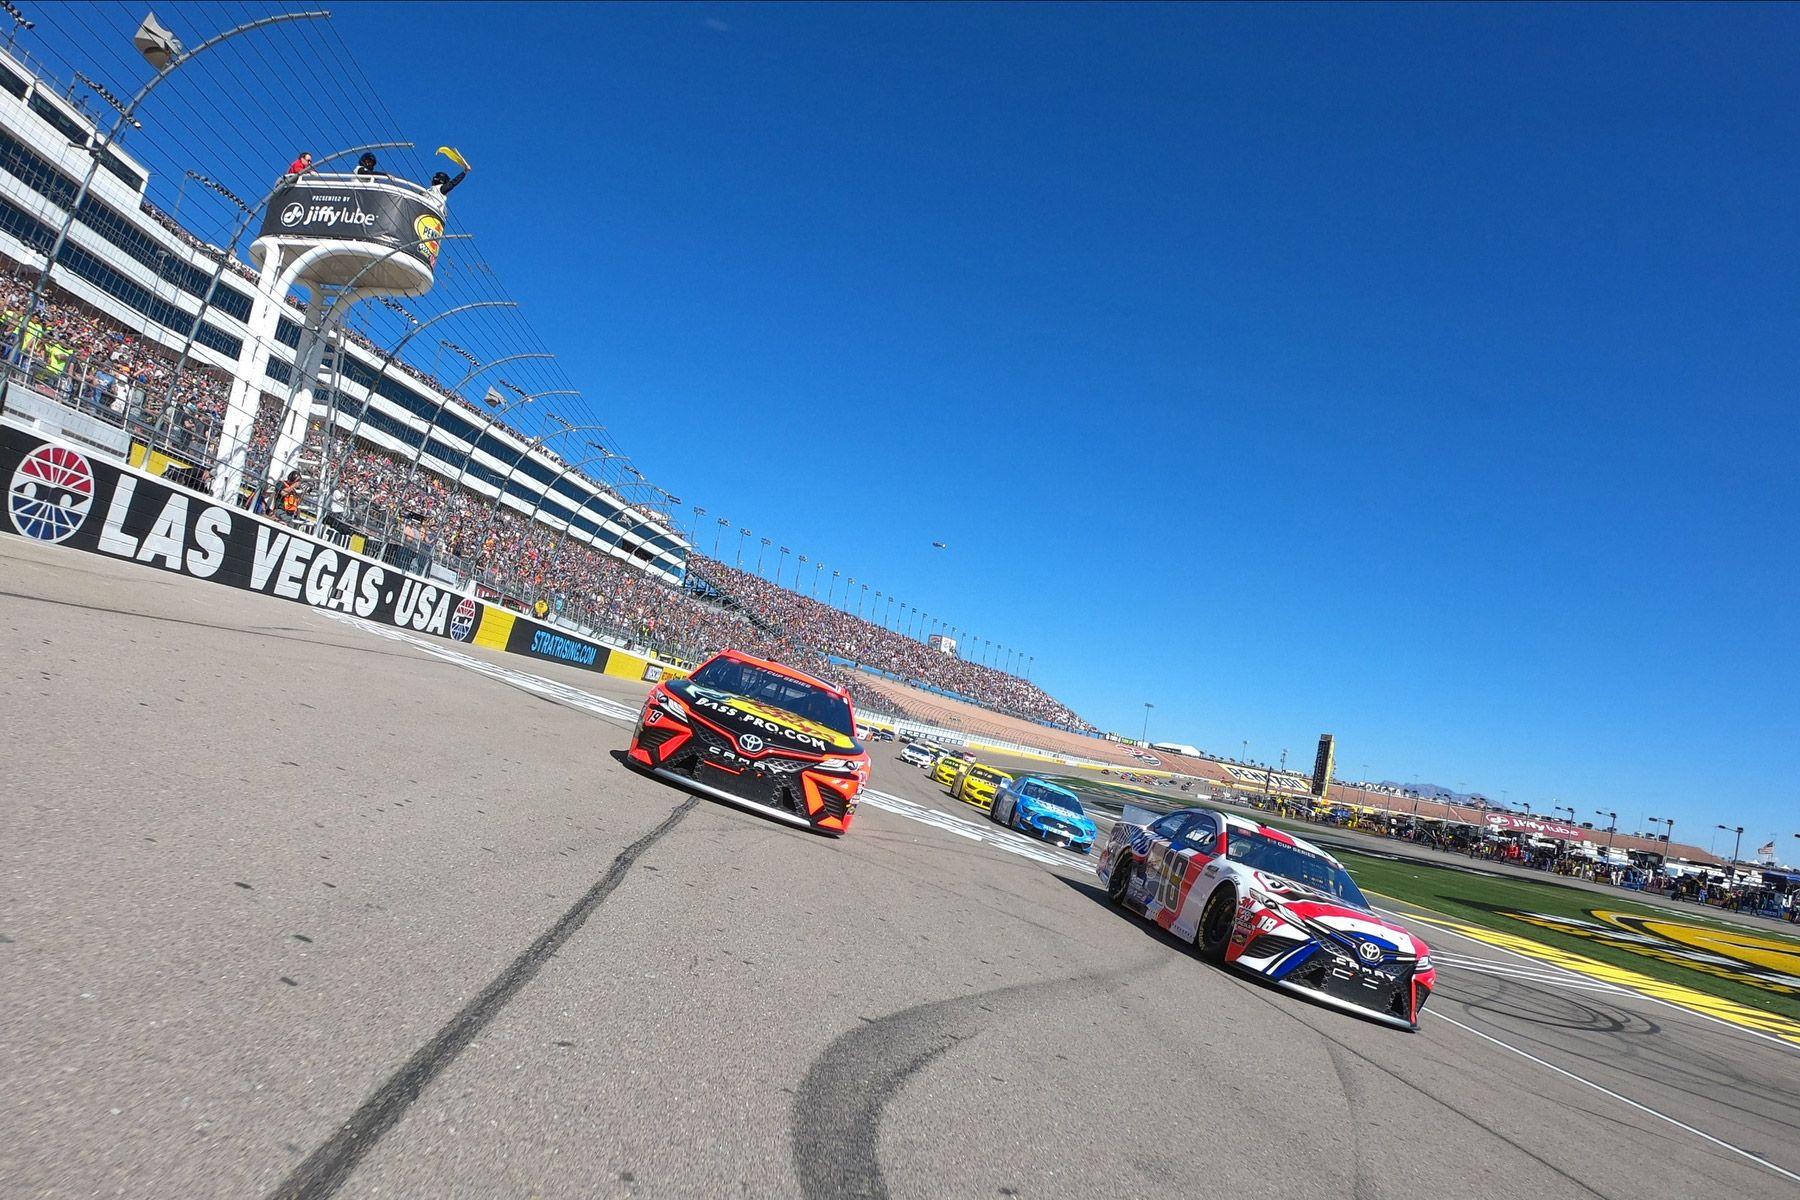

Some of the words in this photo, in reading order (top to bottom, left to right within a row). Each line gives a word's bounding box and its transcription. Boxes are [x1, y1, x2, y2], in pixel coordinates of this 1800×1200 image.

[97, 474, 232, 578] LAS
[250, 525, 384, 617] VEGAS
[394, 578, 452, 636] USA
[531, 630, 597, 665] STRATRISING.COM
[649, 709, 664, 724] 19
[709, 746, 783, 776] CAMRY
[1277, 842, 1292, 850] CUP
[1292, 847, 1316, 859] SERIES
[1256, 915, 1278, 933] 18
[1336, 956, 1396, 982] CAMRY
